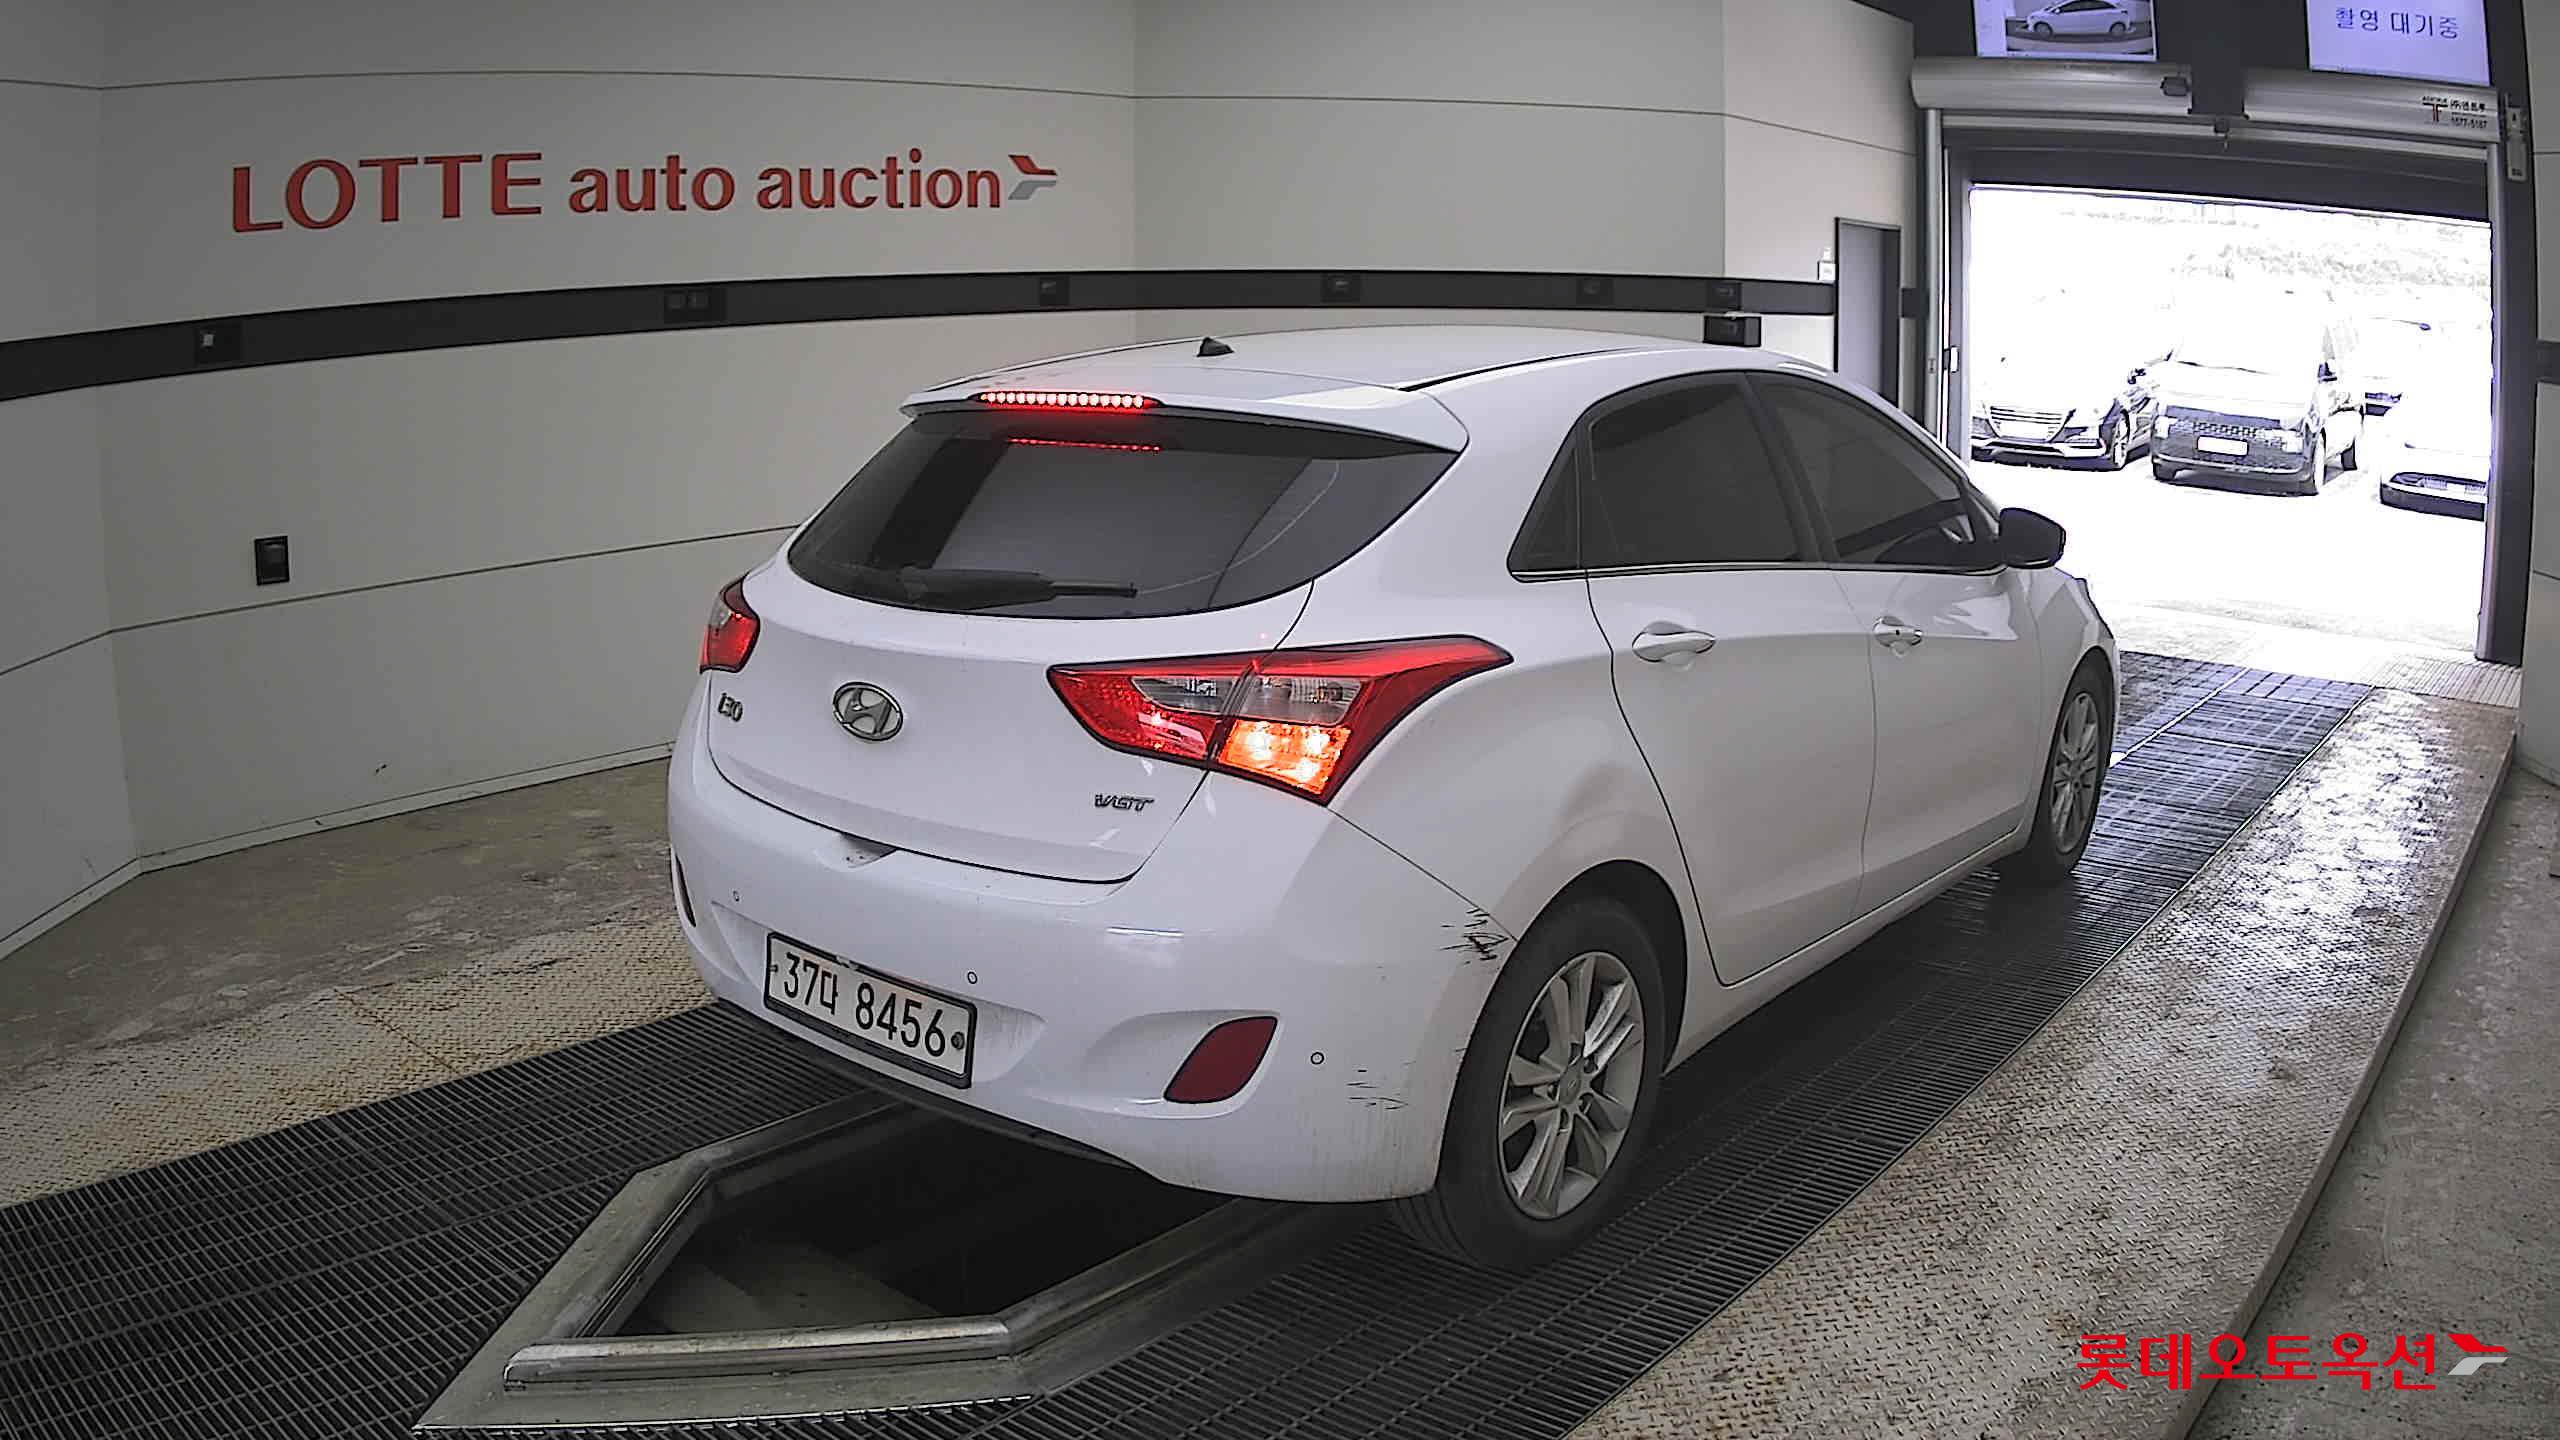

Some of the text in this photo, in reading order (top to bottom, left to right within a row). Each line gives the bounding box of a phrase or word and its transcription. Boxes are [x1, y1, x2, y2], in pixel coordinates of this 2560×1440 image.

[2336, 7, 2458, 39] 촬영 대기중
[232, 147, 1001, 233] LOTTE auto auction
[784, 951, 946, 1057] 37다 8456
